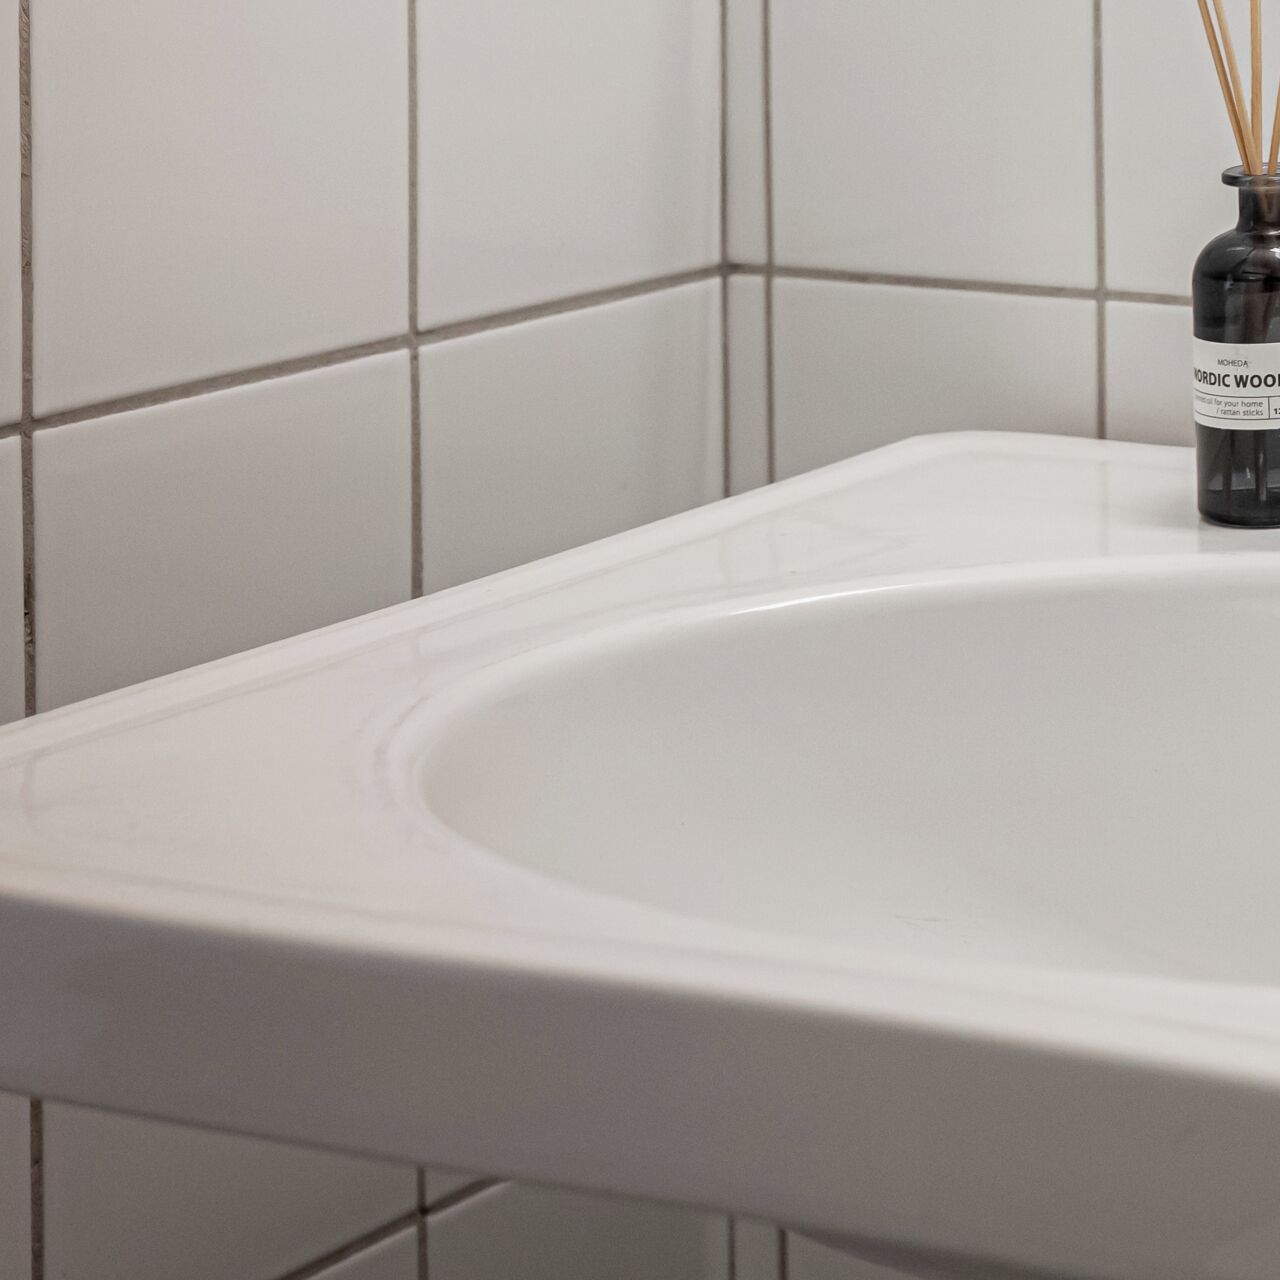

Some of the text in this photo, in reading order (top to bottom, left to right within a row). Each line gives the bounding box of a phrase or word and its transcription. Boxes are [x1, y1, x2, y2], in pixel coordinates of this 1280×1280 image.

[1217, 359, 1249, 368] MOHEDA
[1214, 399, 1223, 407] for
[1223, 400, 1240, 408] your
[1220, 408, 1241, 416] rattan
[1242, 408, 1264, 416] sticks
